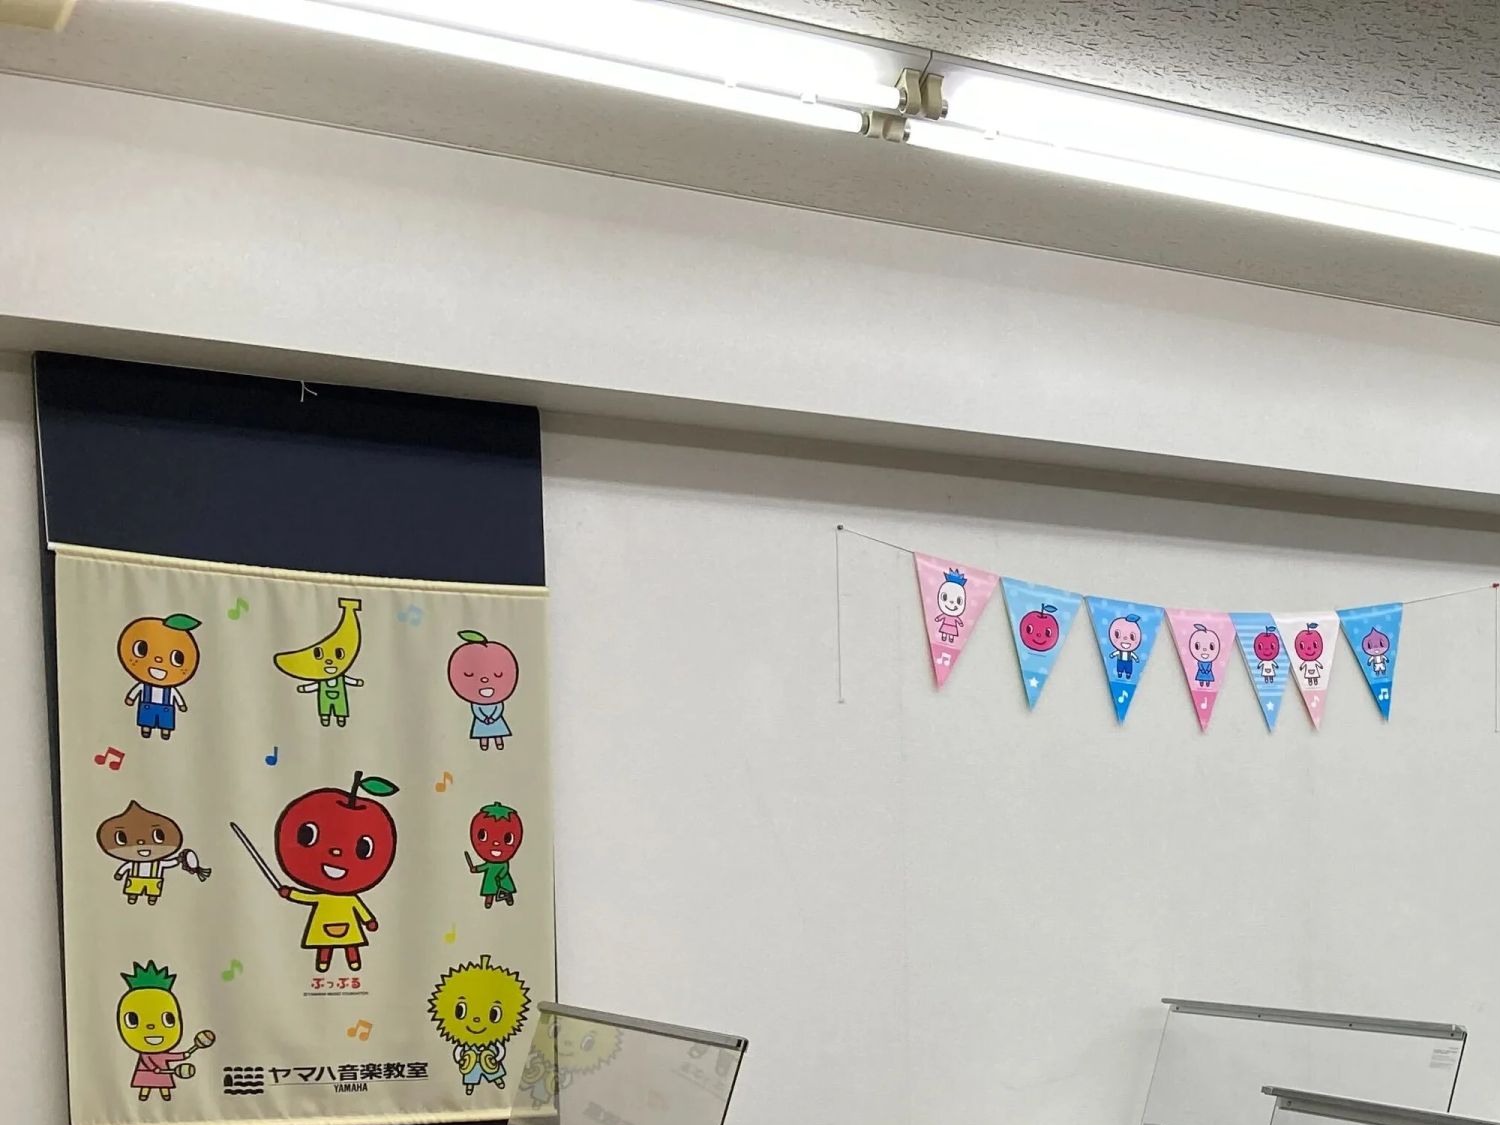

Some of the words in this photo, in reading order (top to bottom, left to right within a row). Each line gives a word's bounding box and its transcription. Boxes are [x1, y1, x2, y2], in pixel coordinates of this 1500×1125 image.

[268, 1062, 429, 1083] ヤマハ音楽教室
[333, 1083, 368, 1093] YAMAHA
